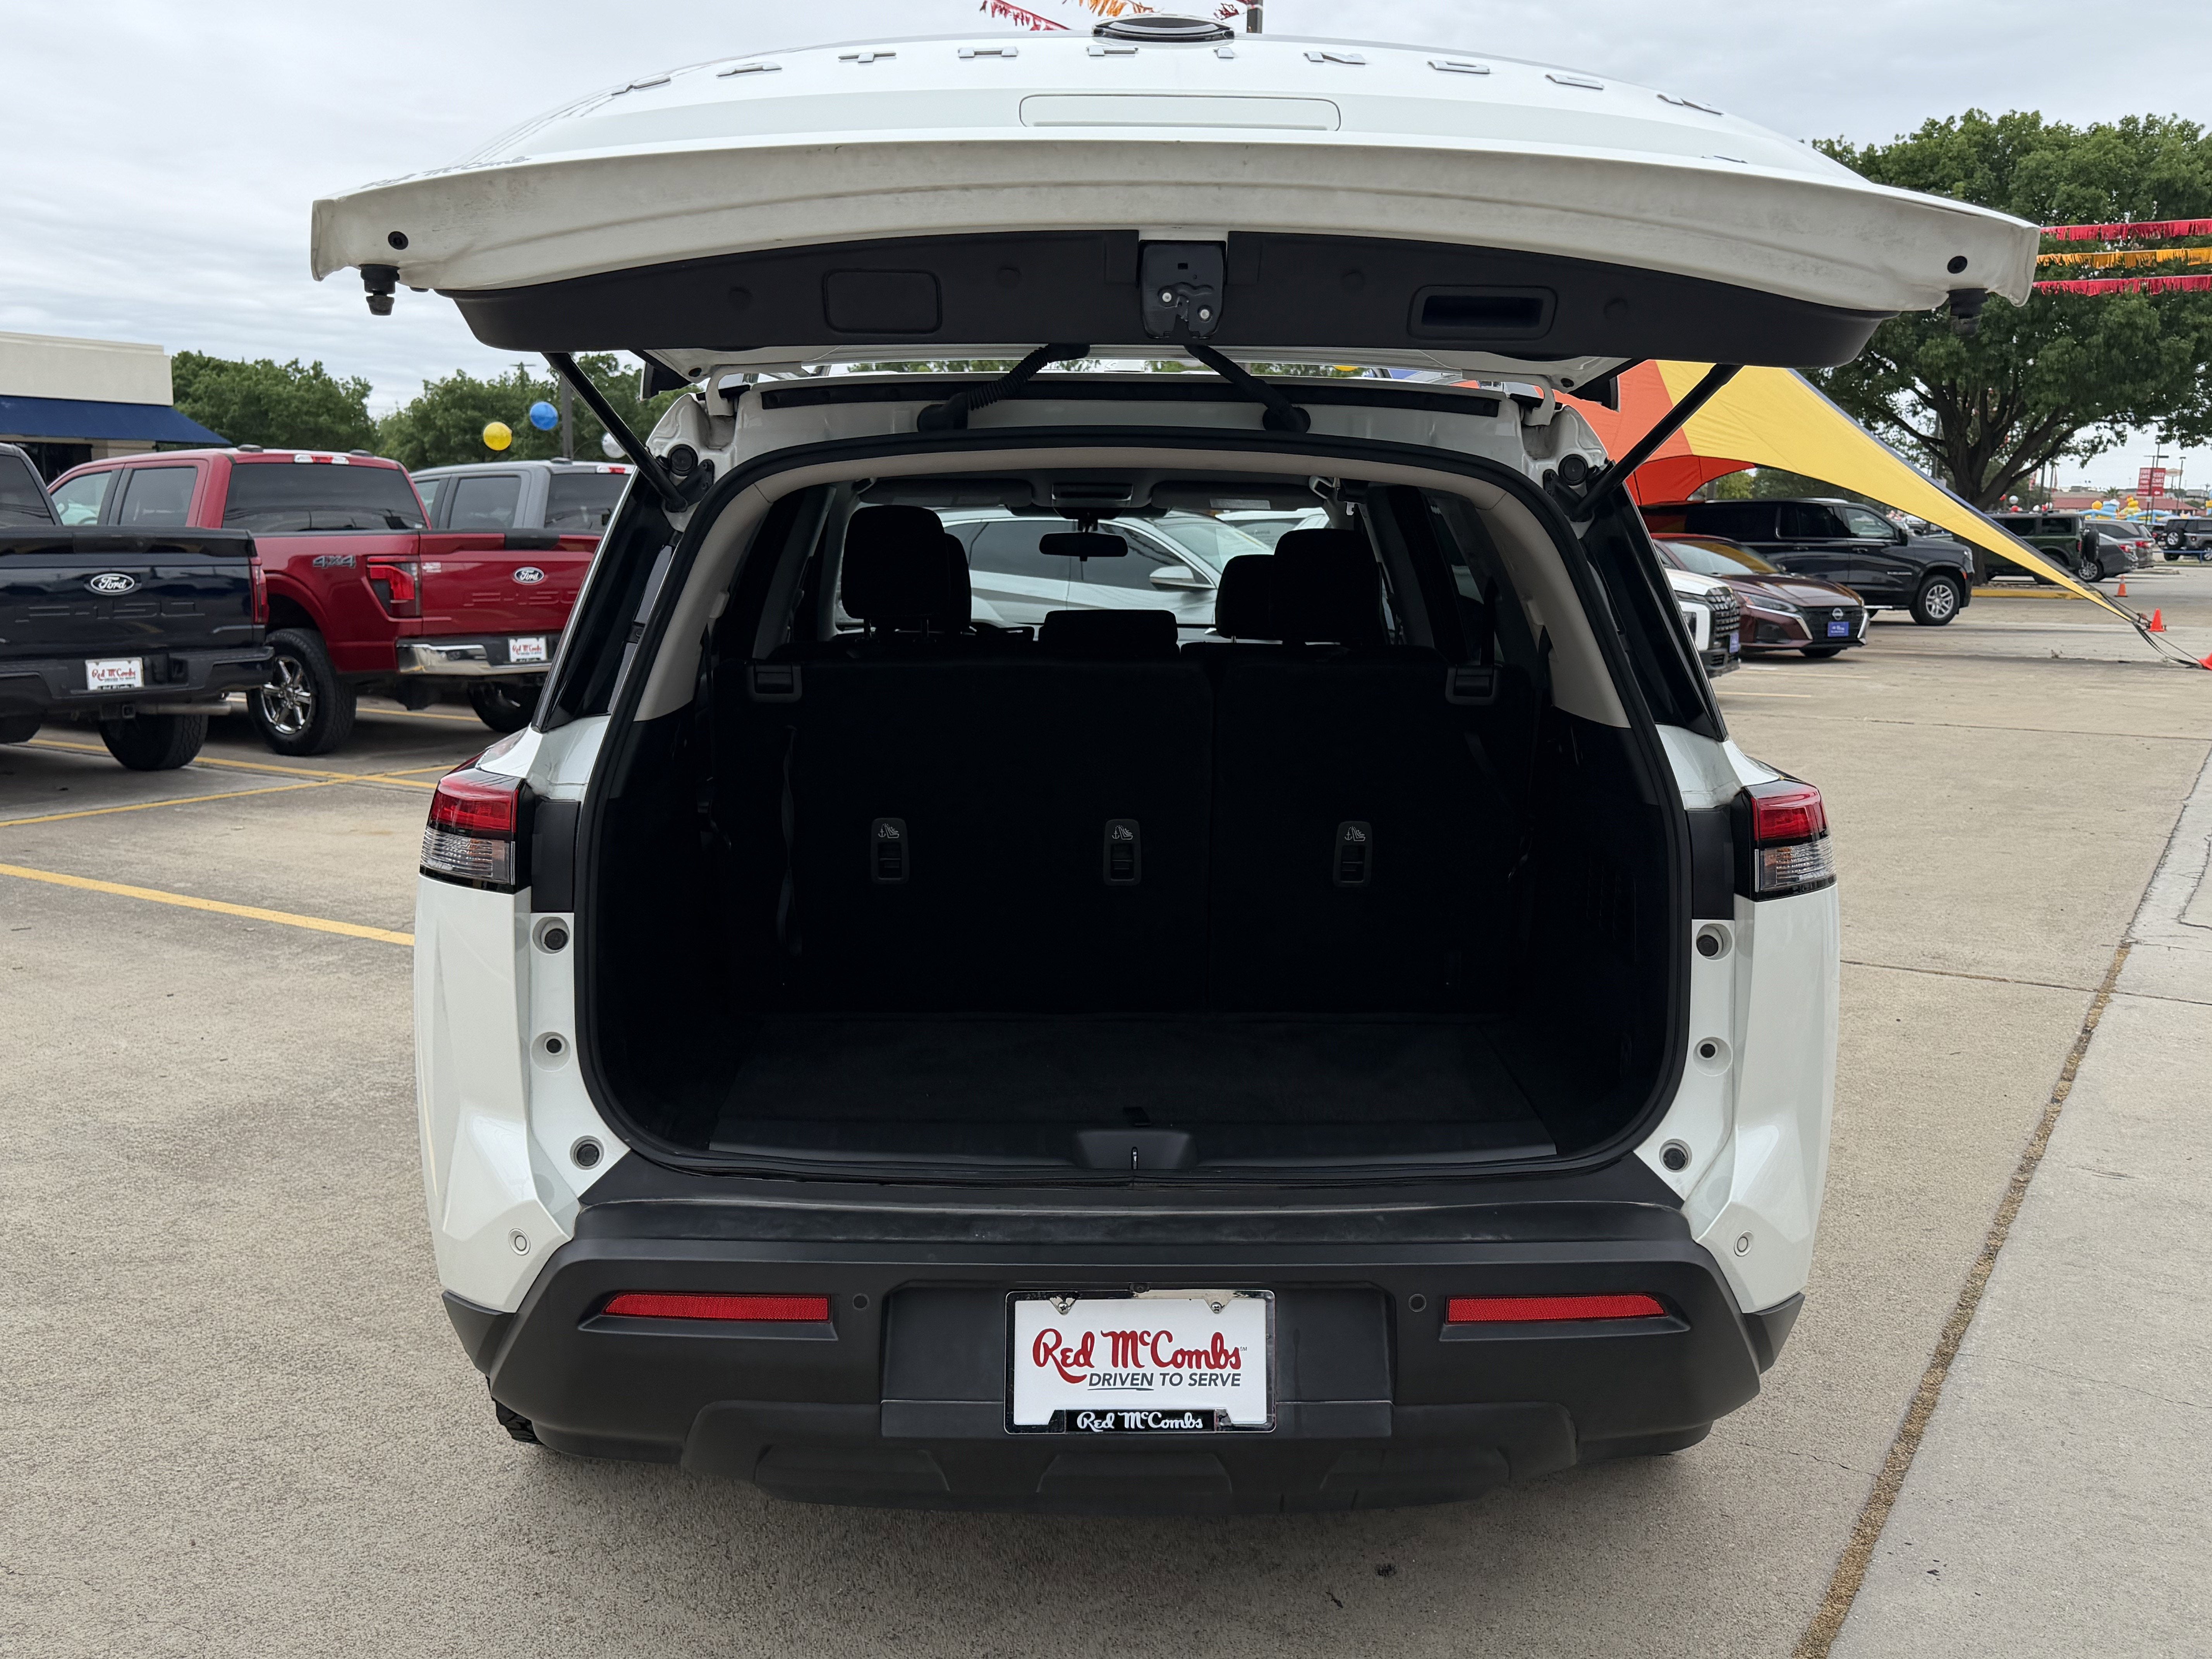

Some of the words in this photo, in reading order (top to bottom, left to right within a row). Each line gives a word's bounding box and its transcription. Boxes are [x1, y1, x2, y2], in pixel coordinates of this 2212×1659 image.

[520, 570, 539, 580] Ford
[98, 576, 127, 589] Ford
[92, 669, 105, 681] Red
[1032, 1328, 1095, 1384] Red
[1101, 1330, 1241, 1369] McCombs
[1088, 1373, 1154, 1386] DRIVEN
[1159, 1373, 1183, 1386] TO
[1188, 1373, 1241, 1386] SERVE
[1077, 1412, 1115, 1432] Red
[1118, 1412, 1203, 1429] McCombs
